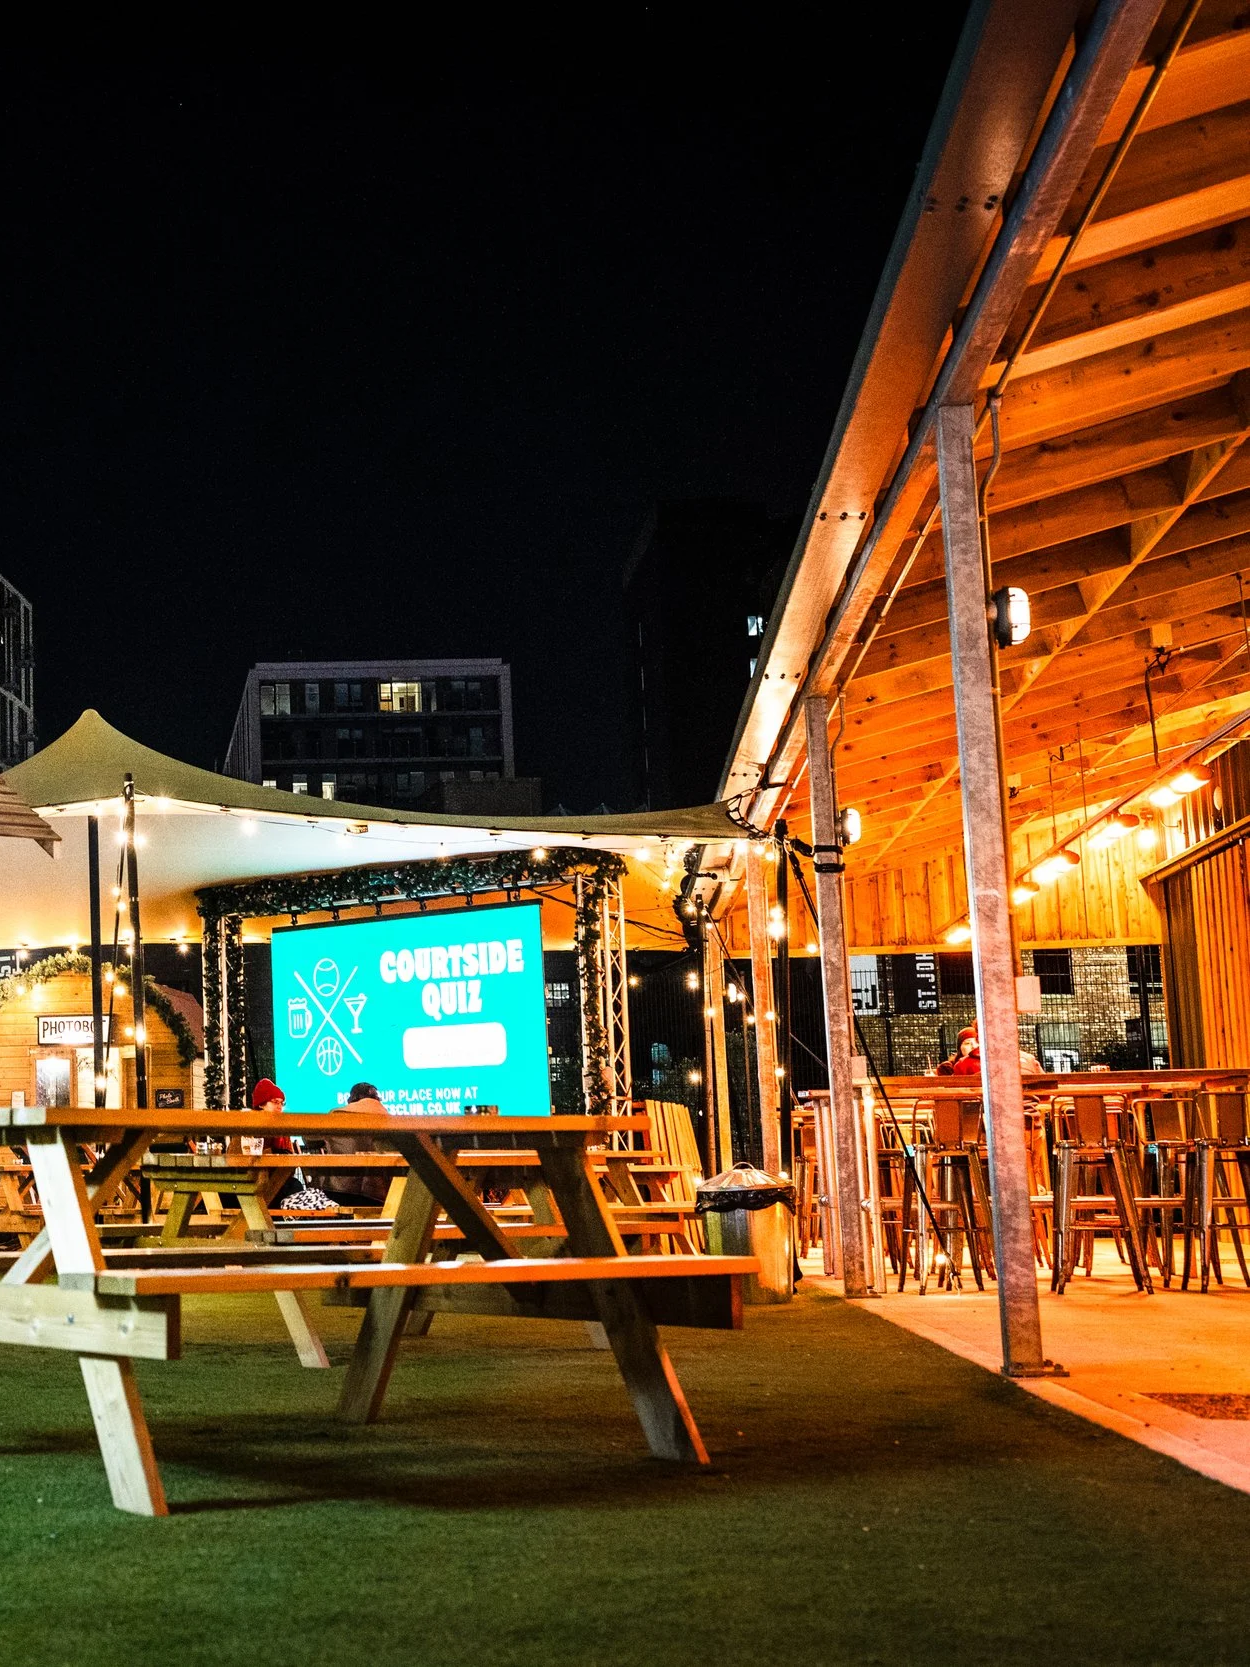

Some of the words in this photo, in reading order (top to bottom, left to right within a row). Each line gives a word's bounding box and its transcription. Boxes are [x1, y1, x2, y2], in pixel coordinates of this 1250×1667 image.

[380, 939, 524, 983] COURTSIDE
[422, 980, 482, 1021] QUIZ
[376, 1090, 395, 1102] OUR
[398, 1088, 432, 1102] PLACE
[435, 1087, 461, 1100] NOW
[464, 1086, 478, 1099] AT
